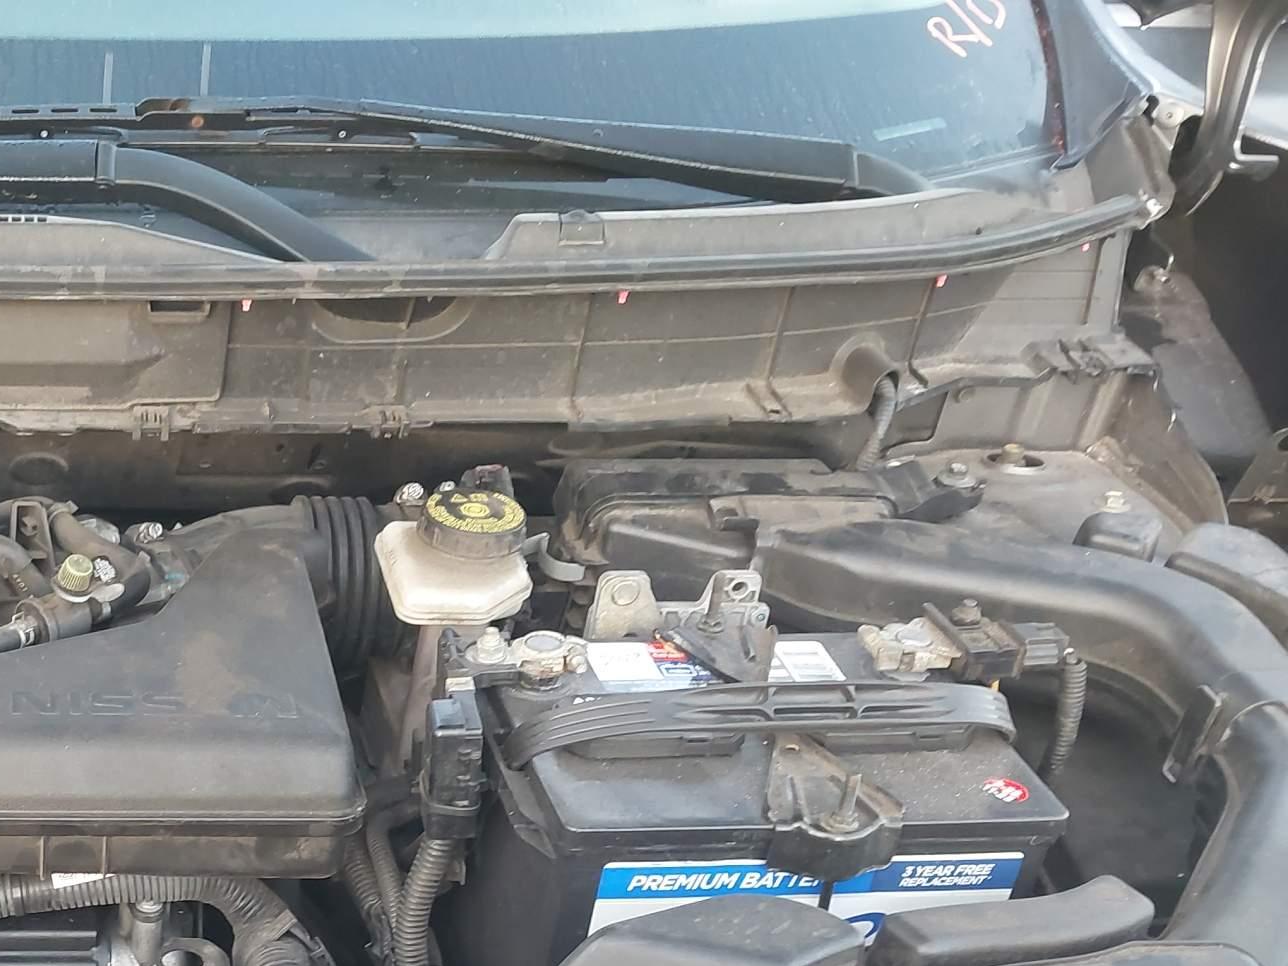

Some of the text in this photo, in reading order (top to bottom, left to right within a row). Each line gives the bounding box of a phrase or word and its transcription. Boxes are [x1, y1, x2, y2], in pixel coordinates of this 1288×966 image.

[901, 863, 996, 877] 3 YEAR FREE
[626, 870, 825, 892] PREMIUM BATTE
